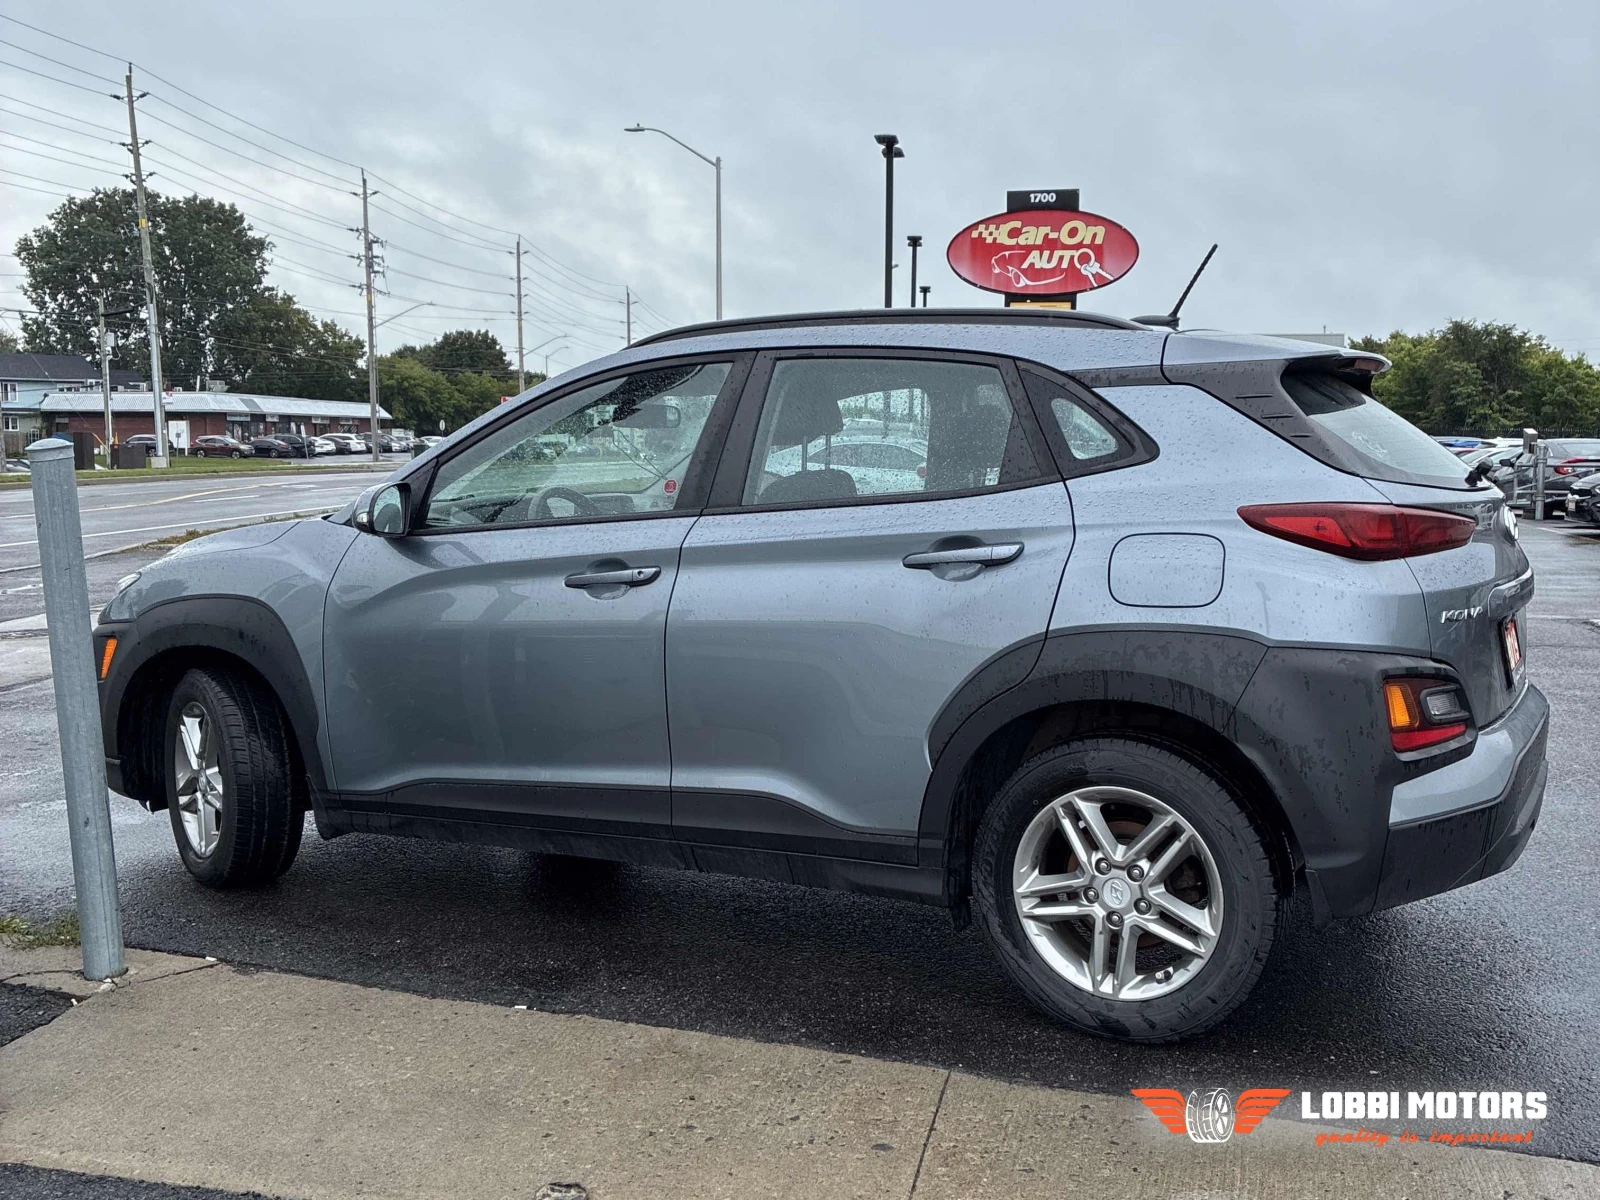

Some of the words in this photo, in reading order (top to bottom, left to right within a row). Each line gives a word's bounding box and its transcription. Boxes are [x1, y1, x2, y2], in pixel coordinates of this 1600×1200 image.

[1029, 192, 1057, 203] 1700
[1001, 220, 1106, 246] Car-On
[1020, 248, 1096, 270] AUTO
